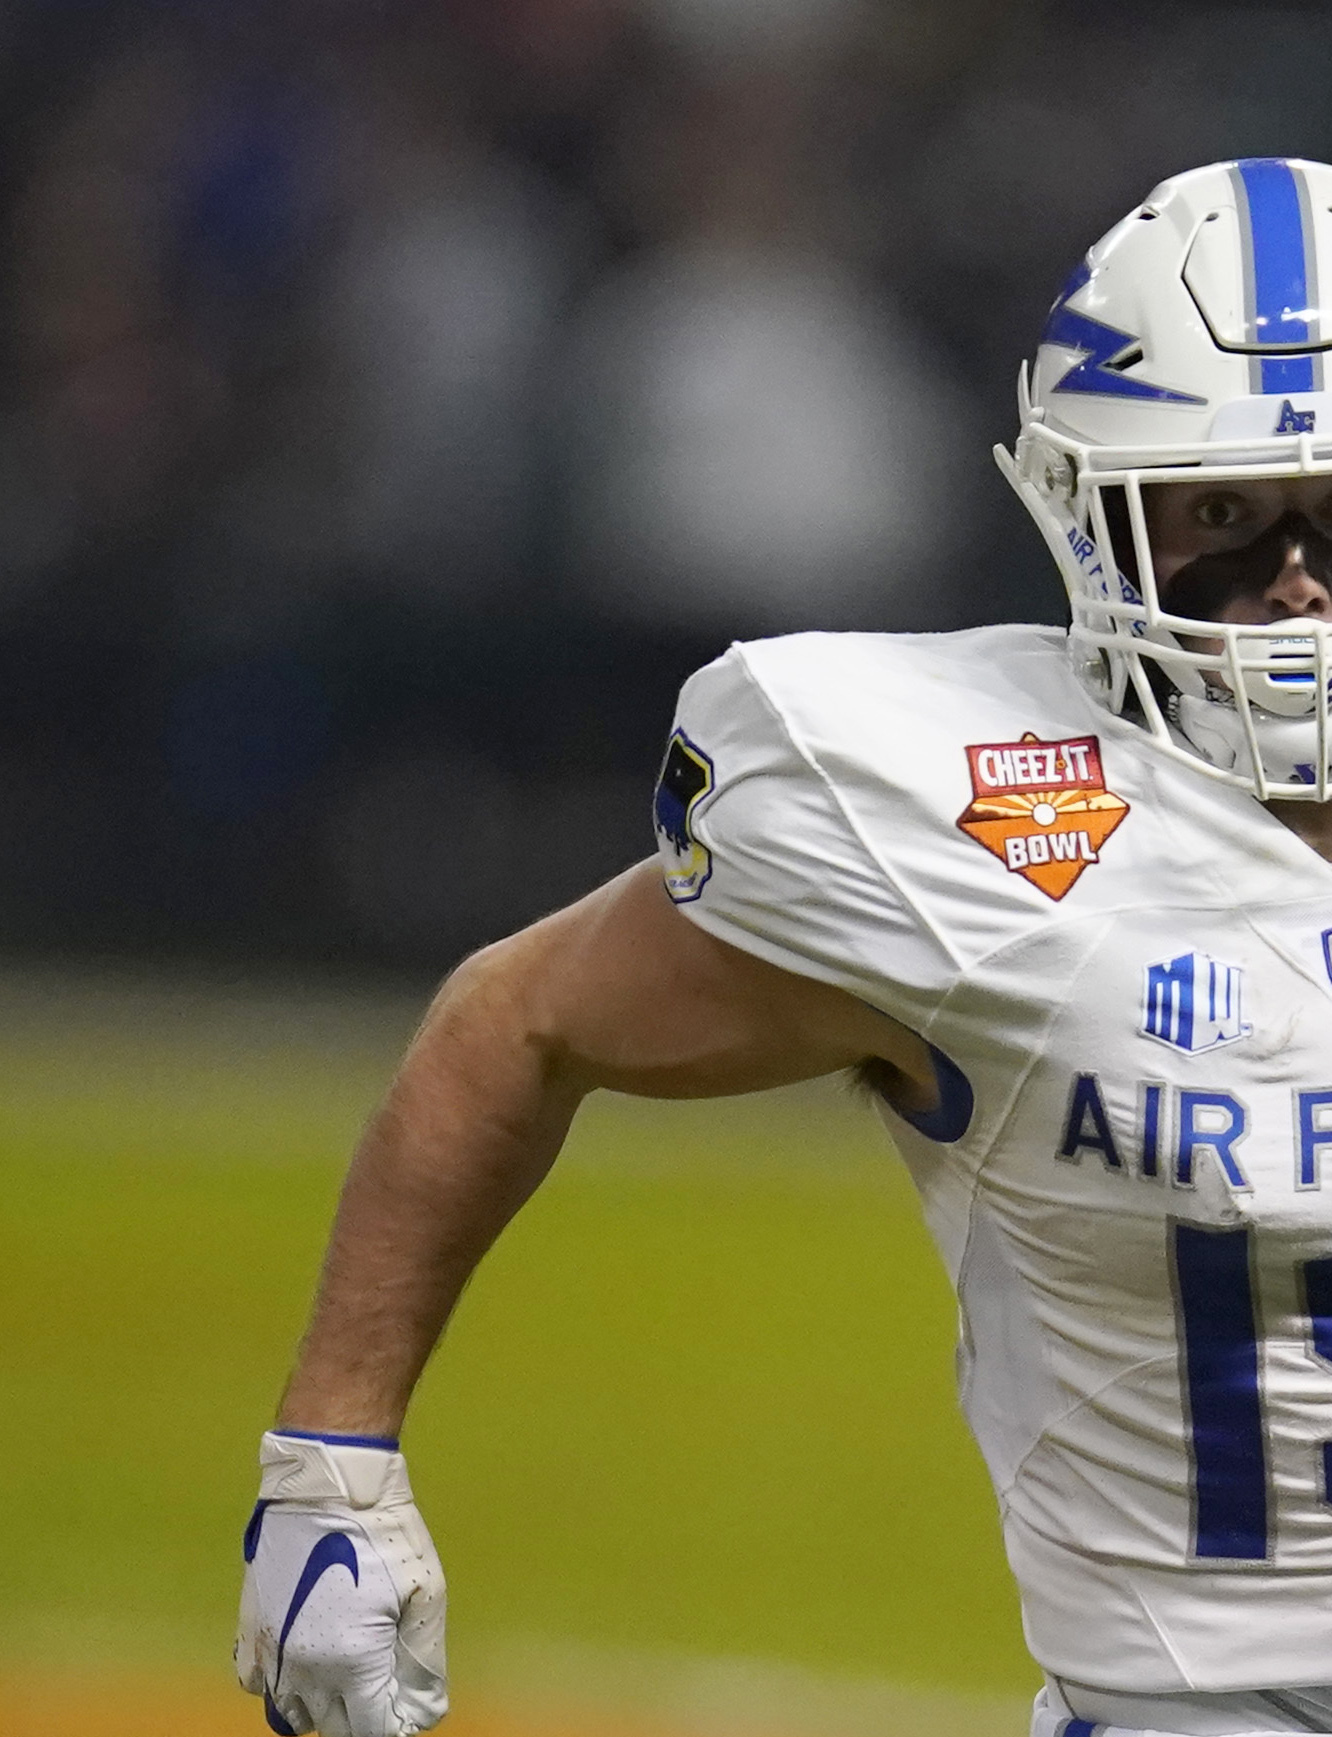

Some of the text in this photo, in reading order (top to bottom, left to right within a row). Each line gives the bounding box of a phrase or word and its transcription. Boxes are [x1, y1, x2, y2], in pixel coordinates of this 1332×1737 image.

[1067, 526, 1095, 564] AIR
[1004, 831, 1097, 870] BOWL
[1055, 1070, 1255, 1193] AIR
